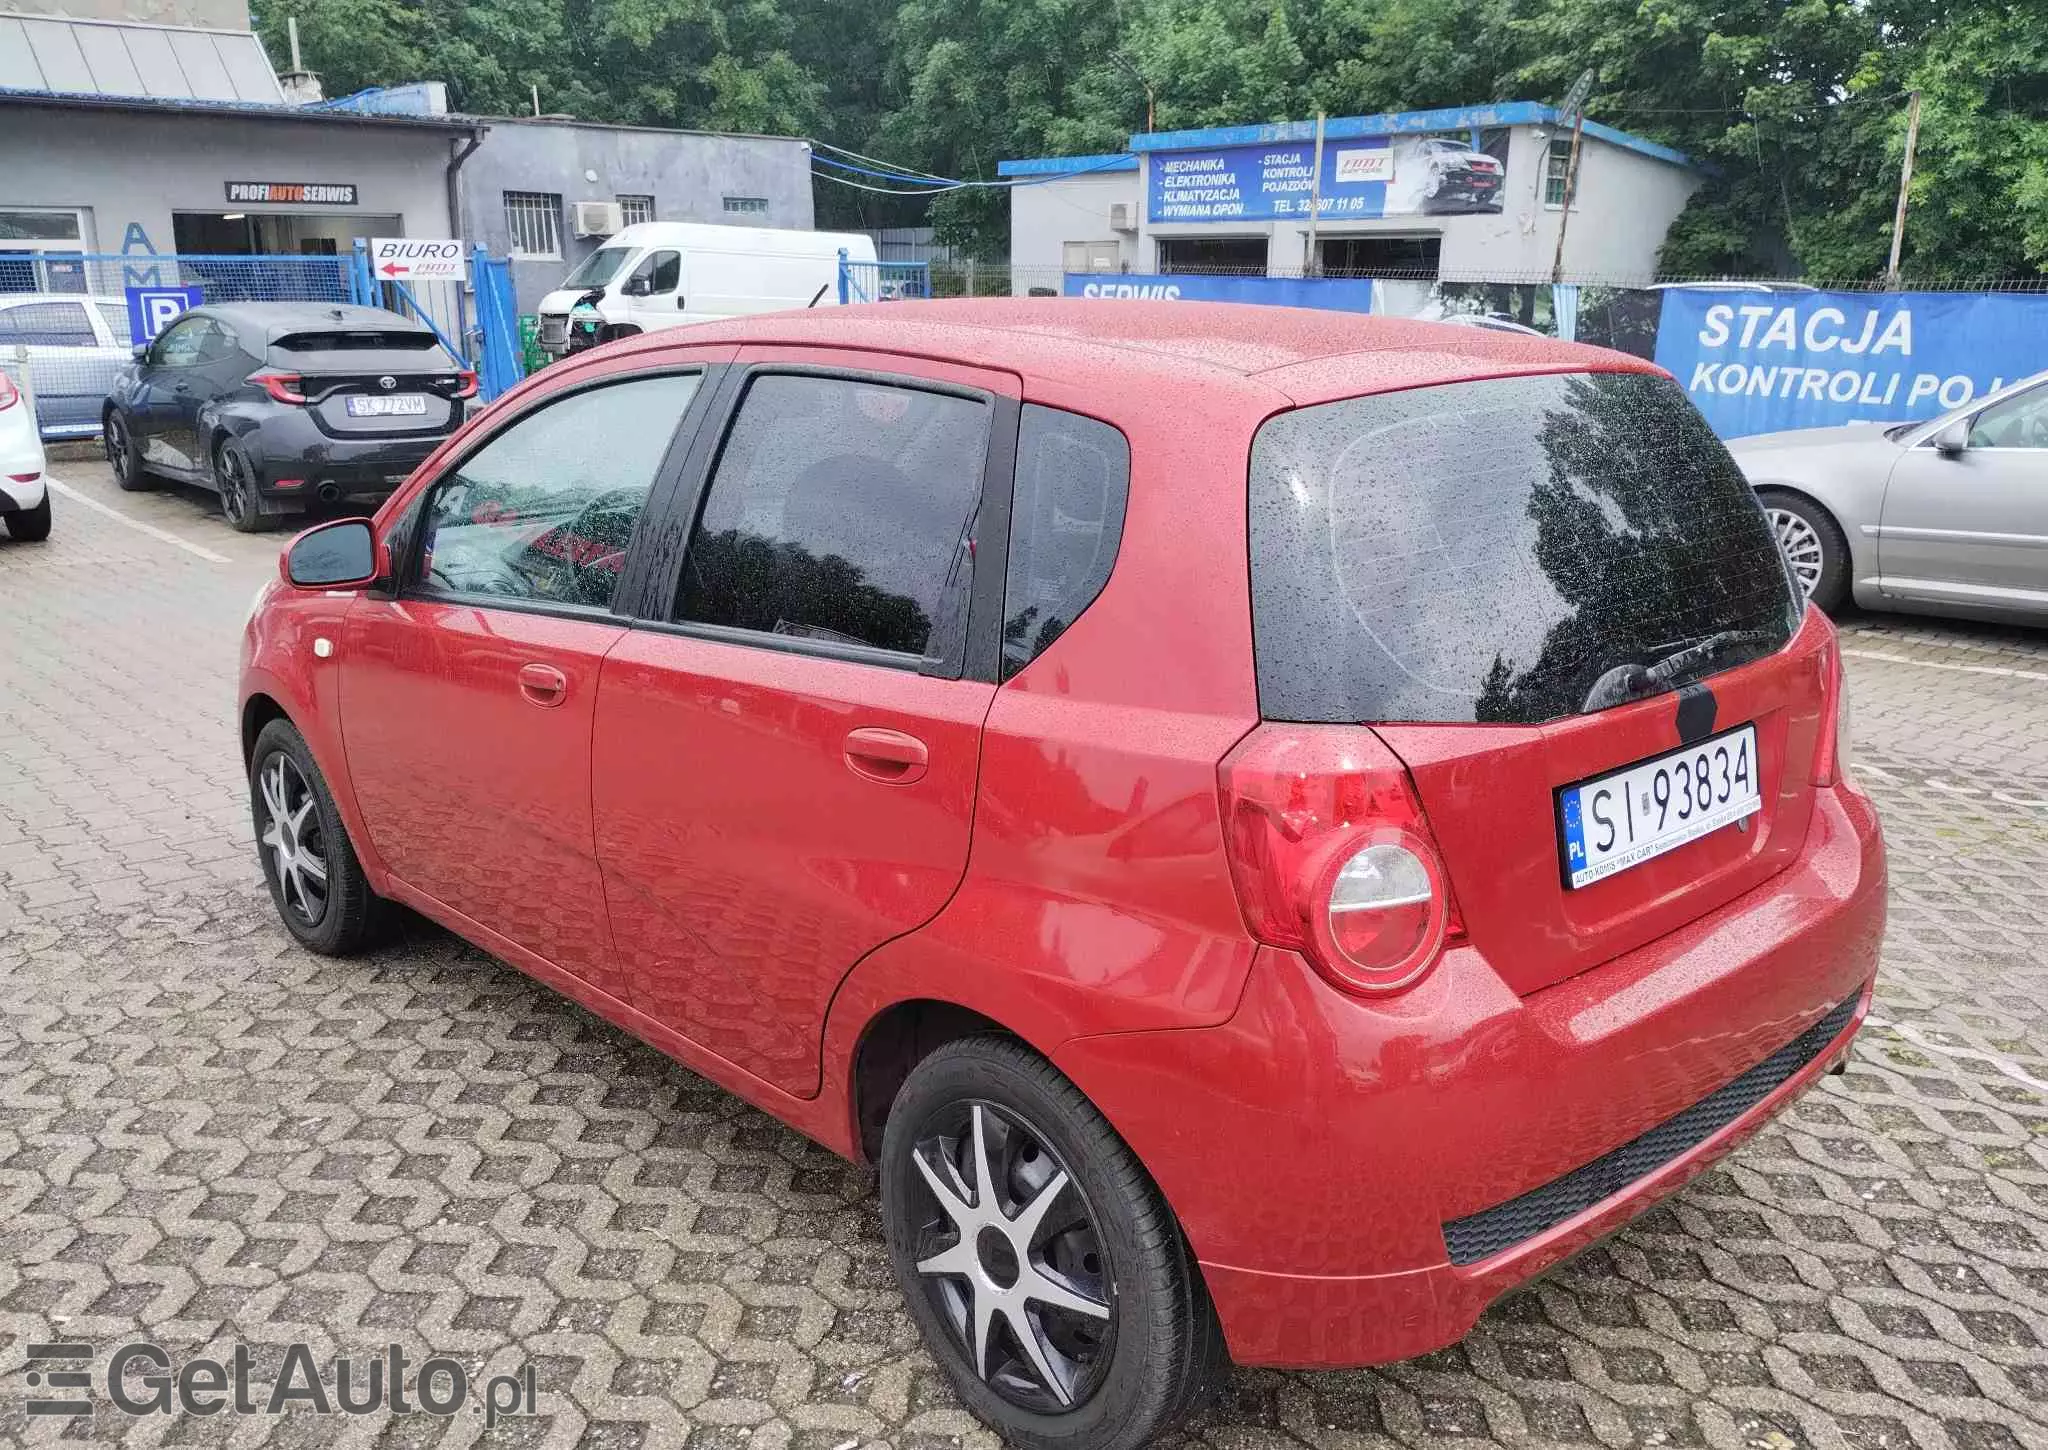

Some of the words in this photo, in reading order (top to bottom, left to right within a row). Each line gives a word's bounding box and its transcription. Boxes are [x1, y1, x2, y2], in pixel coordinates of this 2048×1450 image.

[1262, 166, 1314, 179] KONTROLI
[379, 243, 459, 259] BIURO
[1699, 304, 1913, 356] STACJA
[1689, 362, 1902, 406] KONTROLI
[1592, 780, 1634, 852] SI
[1653, 736, 1749, 831] 93834
[1569, 840, 1585, 861] PL
